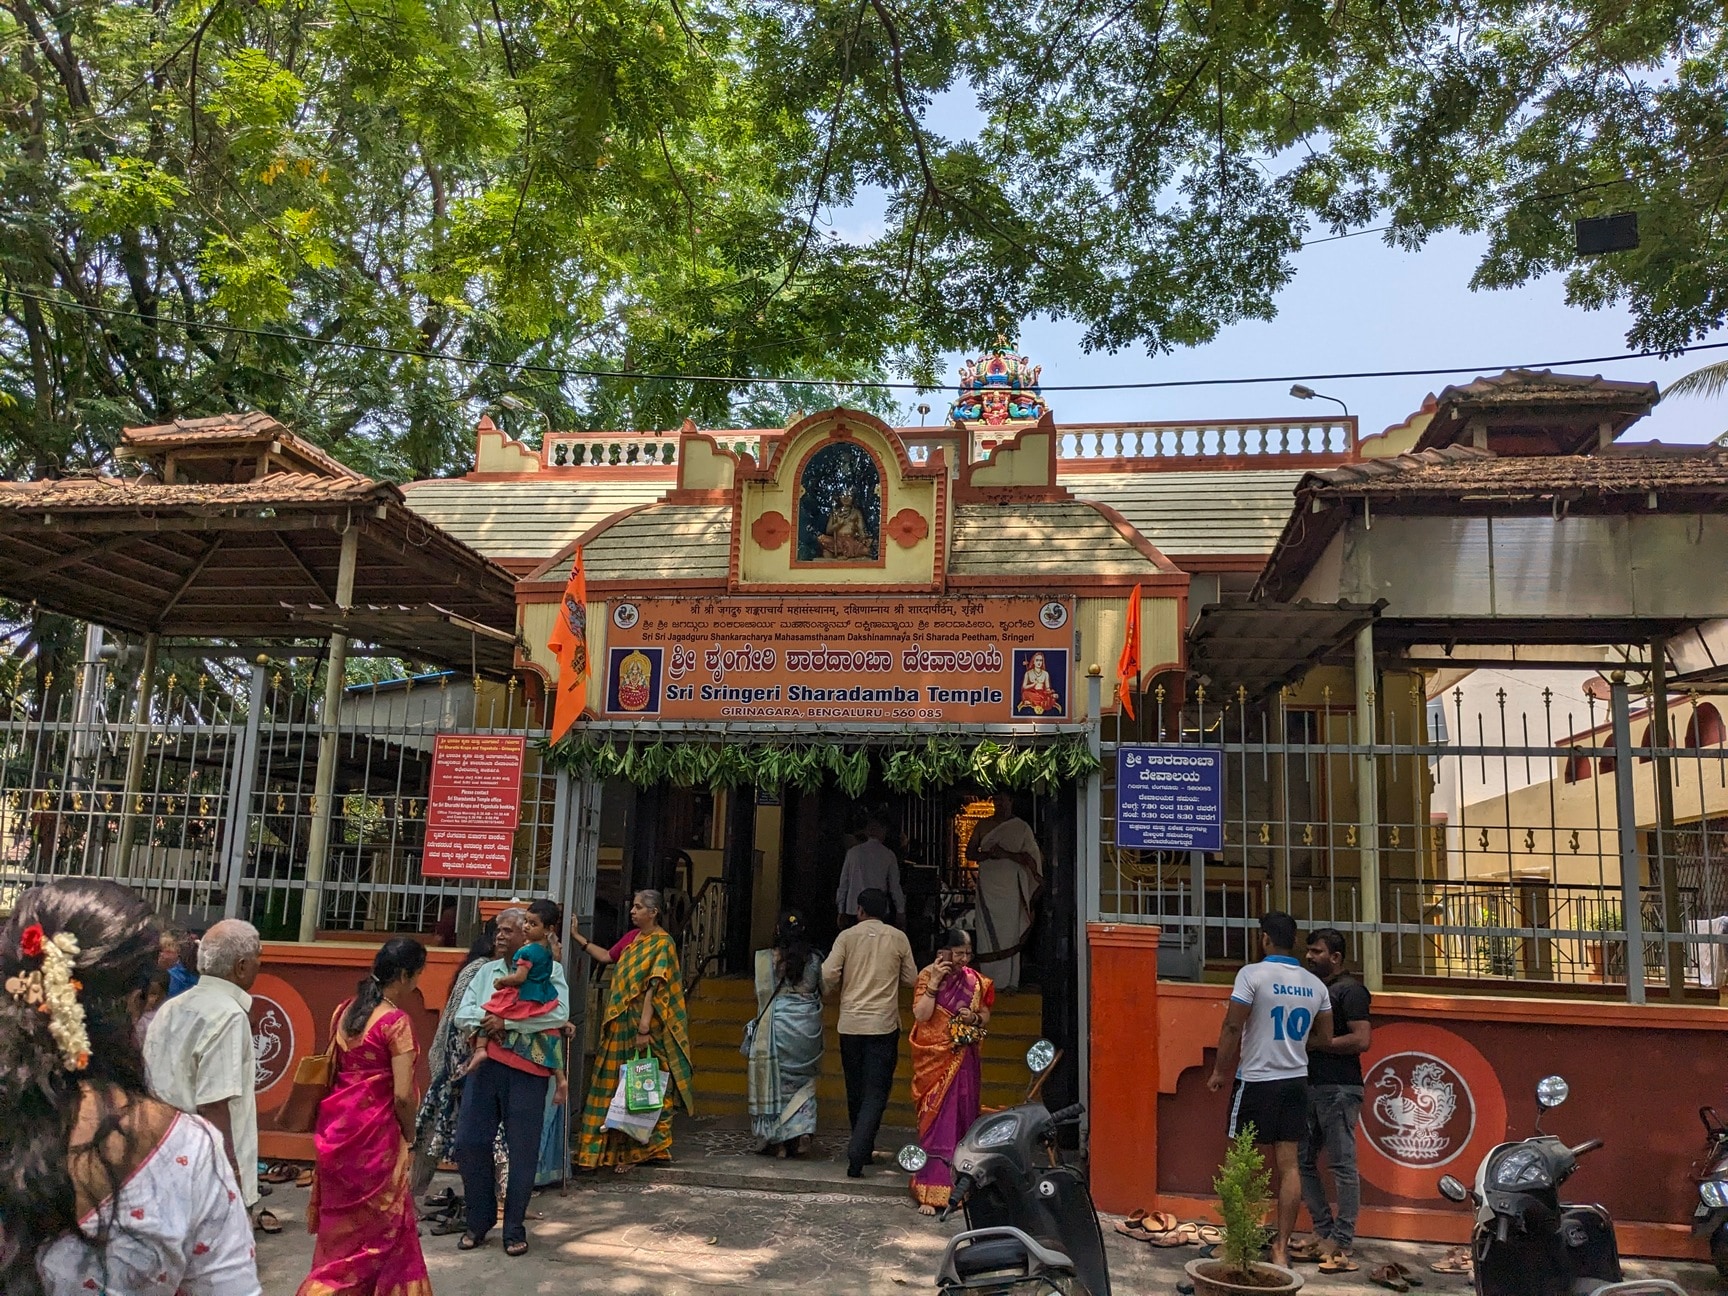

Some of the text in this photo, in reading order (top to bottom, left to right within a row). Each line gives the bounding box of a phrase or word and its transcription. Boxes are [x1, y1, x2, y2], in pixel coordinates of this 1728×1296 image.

[691, 604, 700, 614] श्री
[704, 604, 714, 614] श्री
[718, 606, 741, 617] जगद्गुरु
[787, 605, 838, 616] महासंस्थानम्,
[843, 604, 889, 614] दक्षिणाम्नाय
[894, 604, 904, 614] श्री
[908, 604, 956, 616] शारदापीठम्,
[643, 621, 653, 630] ಶ್ರೀ
[658, 621, 668, 630] ಶ್ರೀ
[672, 621, 709, 632] ಜಗದ್ಗುರು
[713, 621, 776, 629] ಶಂಕರಾಚಾರ್ಯ
[780, 621, 850, 632] ಮಹಾಸಂಸ್ಥಾನಮ್
[918, 620, 929, 630] ಶ್ರೀ
[999, 620, 1035, 631] ಶೃಂಗೇರಿ
[642, 633, 1034, 643] Sri Sri Jagadguru Shankaracharya Mahasamsthanam Dakshinamnaya Sri Sharada Peetham, Sringeri
[669, 643, 1003, 683] ಶ್ರೀ ಶೃಂಗೇರಿ ಶಾರದಾಂಬಾ ದೇವಾಲಯ
[666, 684, 1002, 705] Sri Sringeri Sharadamba Temple
[721, 706, 804, 718] GIRINAGARA,
[808, 707, 882, 717] BENGALURU
[892, 708, 916, 718] 560
[918, 708, 942, 719] 085
[1125, 753, 1214, 767] ಶ್ರೀ ಶಾರದಾಂಬಾ
[1140, 769, 1200, 781] ದೇವಾಲಯ
[1273, 983, 1313, 997] SACHIN
[1270, 1006, 1311, 1041] 10
